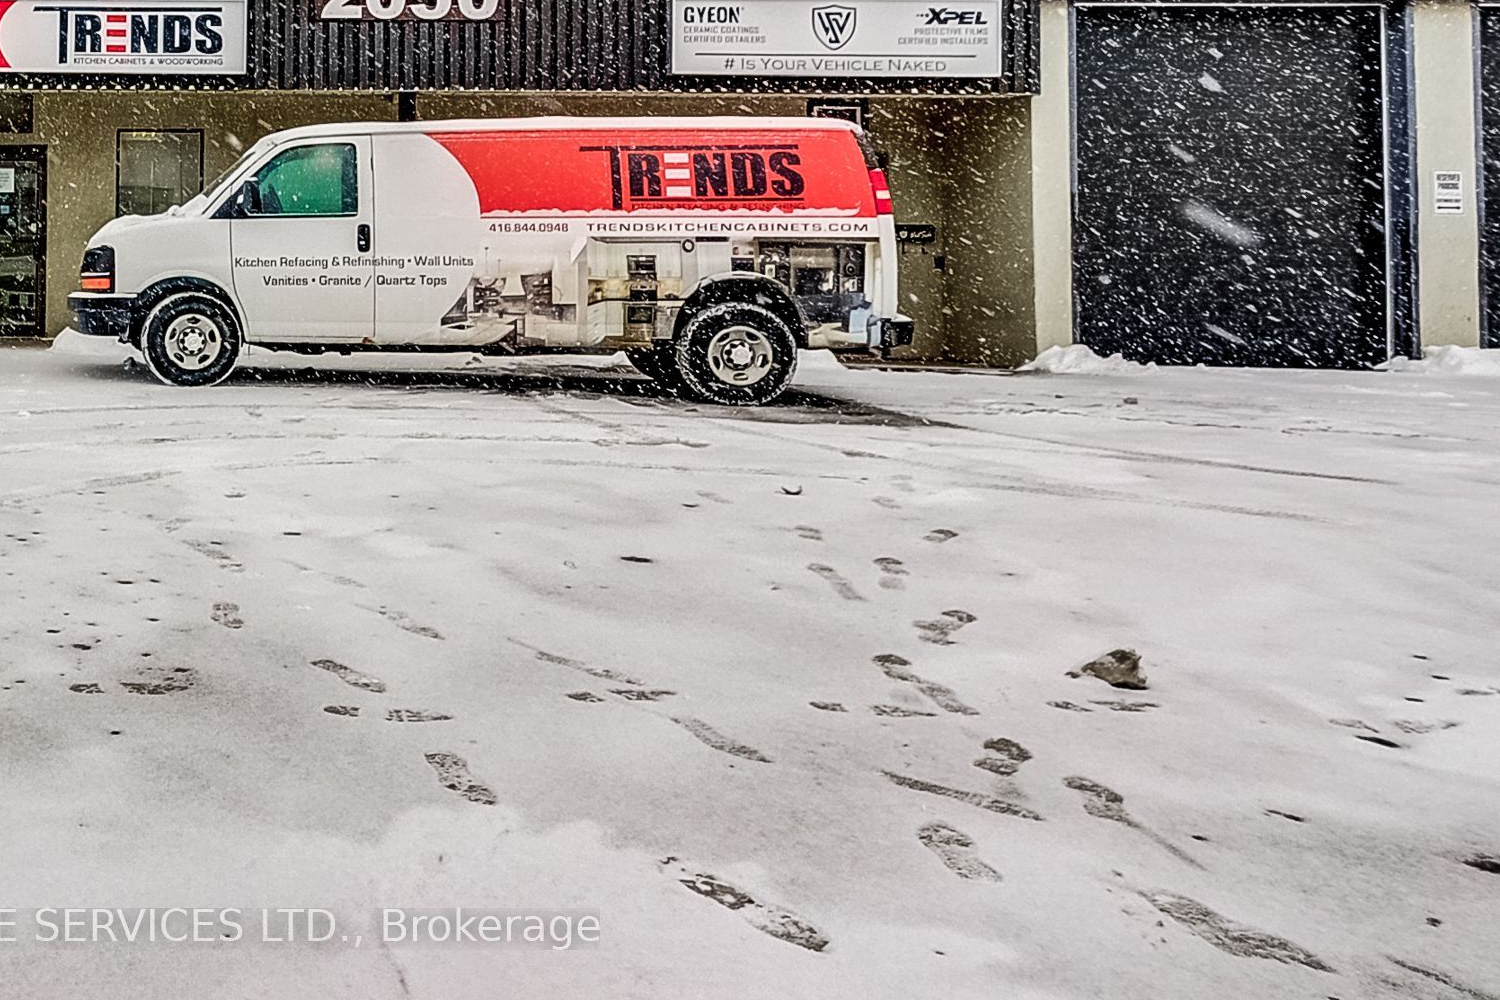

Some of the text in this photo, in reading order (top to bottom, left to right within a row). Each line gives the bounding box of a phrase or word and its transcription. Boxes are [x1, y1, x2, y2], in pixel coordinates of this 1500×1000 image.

[683, 6, 740, 24] GYEON
[925, 7, 988, 25] XPEL
[33, 6, 223, 64] TRENDS
[683, 26, 760, 34] CERAMIC COATINGS
[914, 27, 988, 36] PROTECTIVE FILMS
[683, 35, 766, 44] CERTIFIED DETAILERS
[897, 37, 988, 45] CERTIFIED INSTALLERS
[158, 58, 223, 66] WOODWORKING
[724, 58, 735, 70] #
[579, 144, 805, 210] TRENDS
[489, 223, 869, 232] 416.844.0948 TRENDSKITCHENCABINETS.COM
[234, 256, 474, 269] Kitchen Refacing & Refinishing Wall Units
[263, 275, 309, 286] Vanities
[319, 275, 361, 286] Granite
[376, 275, 416, 286] Quartz
[420, 274, 448, 288] Tops
